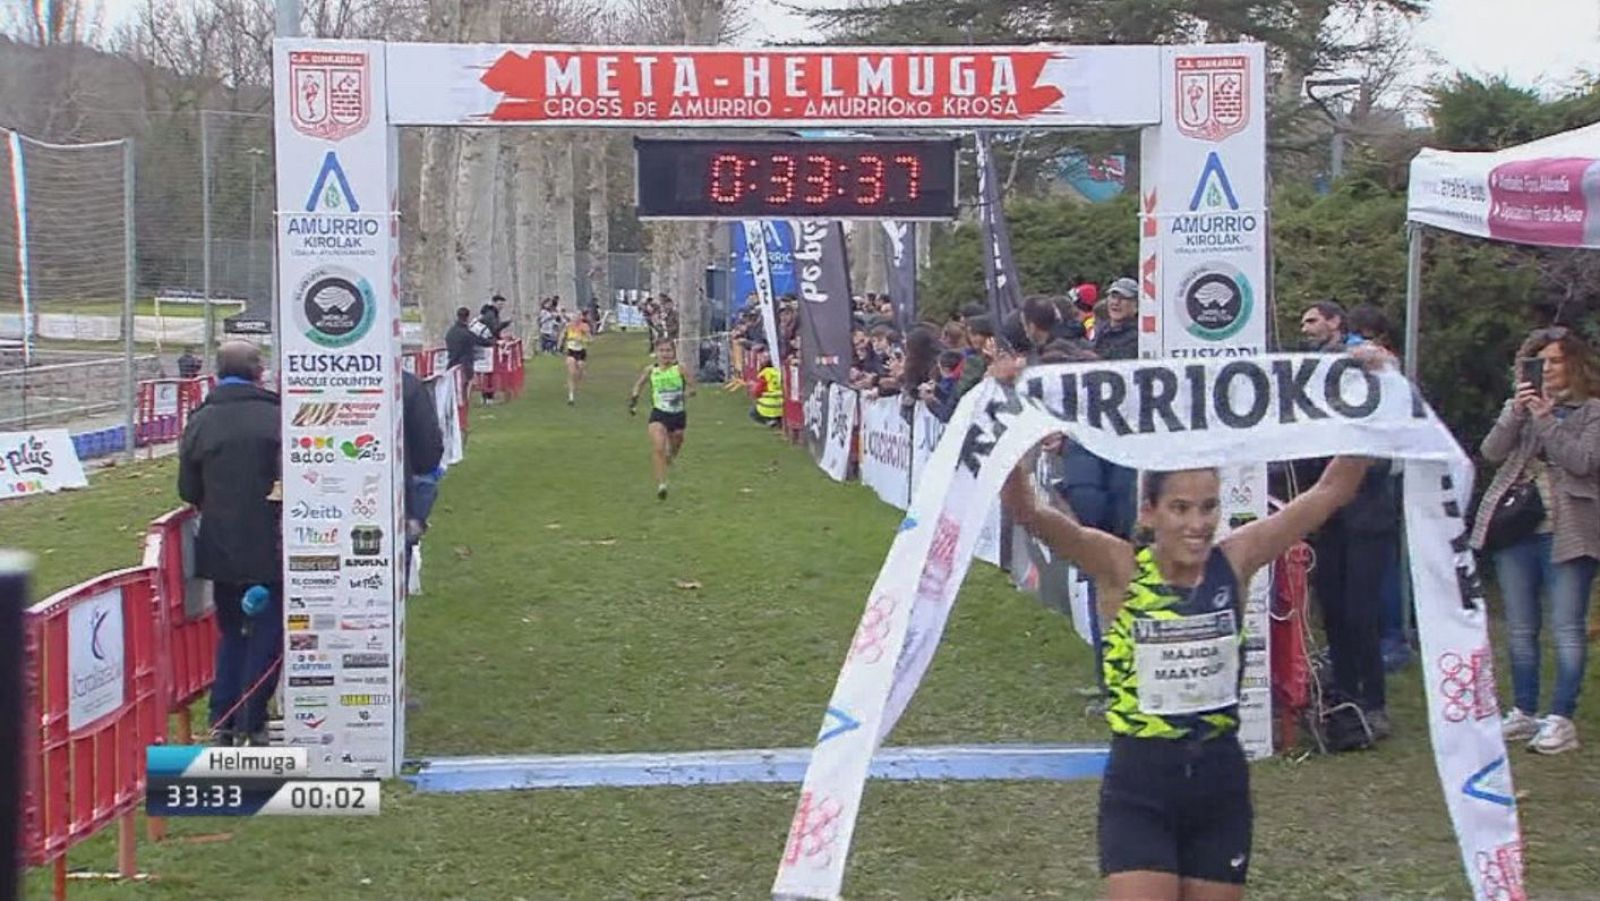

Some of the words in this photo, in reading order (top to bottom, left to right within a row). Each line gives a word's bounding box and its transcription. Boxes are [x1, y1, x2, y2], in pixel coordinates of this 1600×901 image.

[544, 55, 699, 97] META
[744, 55, 1017, 97] HELMUGA
[543, 99, 622, 117] CROSS
[633, 103, 657, 117] DE
[669, 99, 772, 117] AMURRIO
[942, 98, 1019, 116] KROSA
[709, 153, 921, 204] 0:33:37
[287, 217, 379, 236] AMURRIO
[1171, 215, 1257, 234] AMURRIO
[303, 236, 362, 248] KIROLAK
[1186, 234, 1241, 246] KIROLAK
[287, 354, 382, 373] EUSKADI
[288, 376, 327, 387] BASQUE
[329, 376, 383, 387] COUNTRY
[290, 447, 335, 464] adoc
[310, 505, 343, 519] eitb
